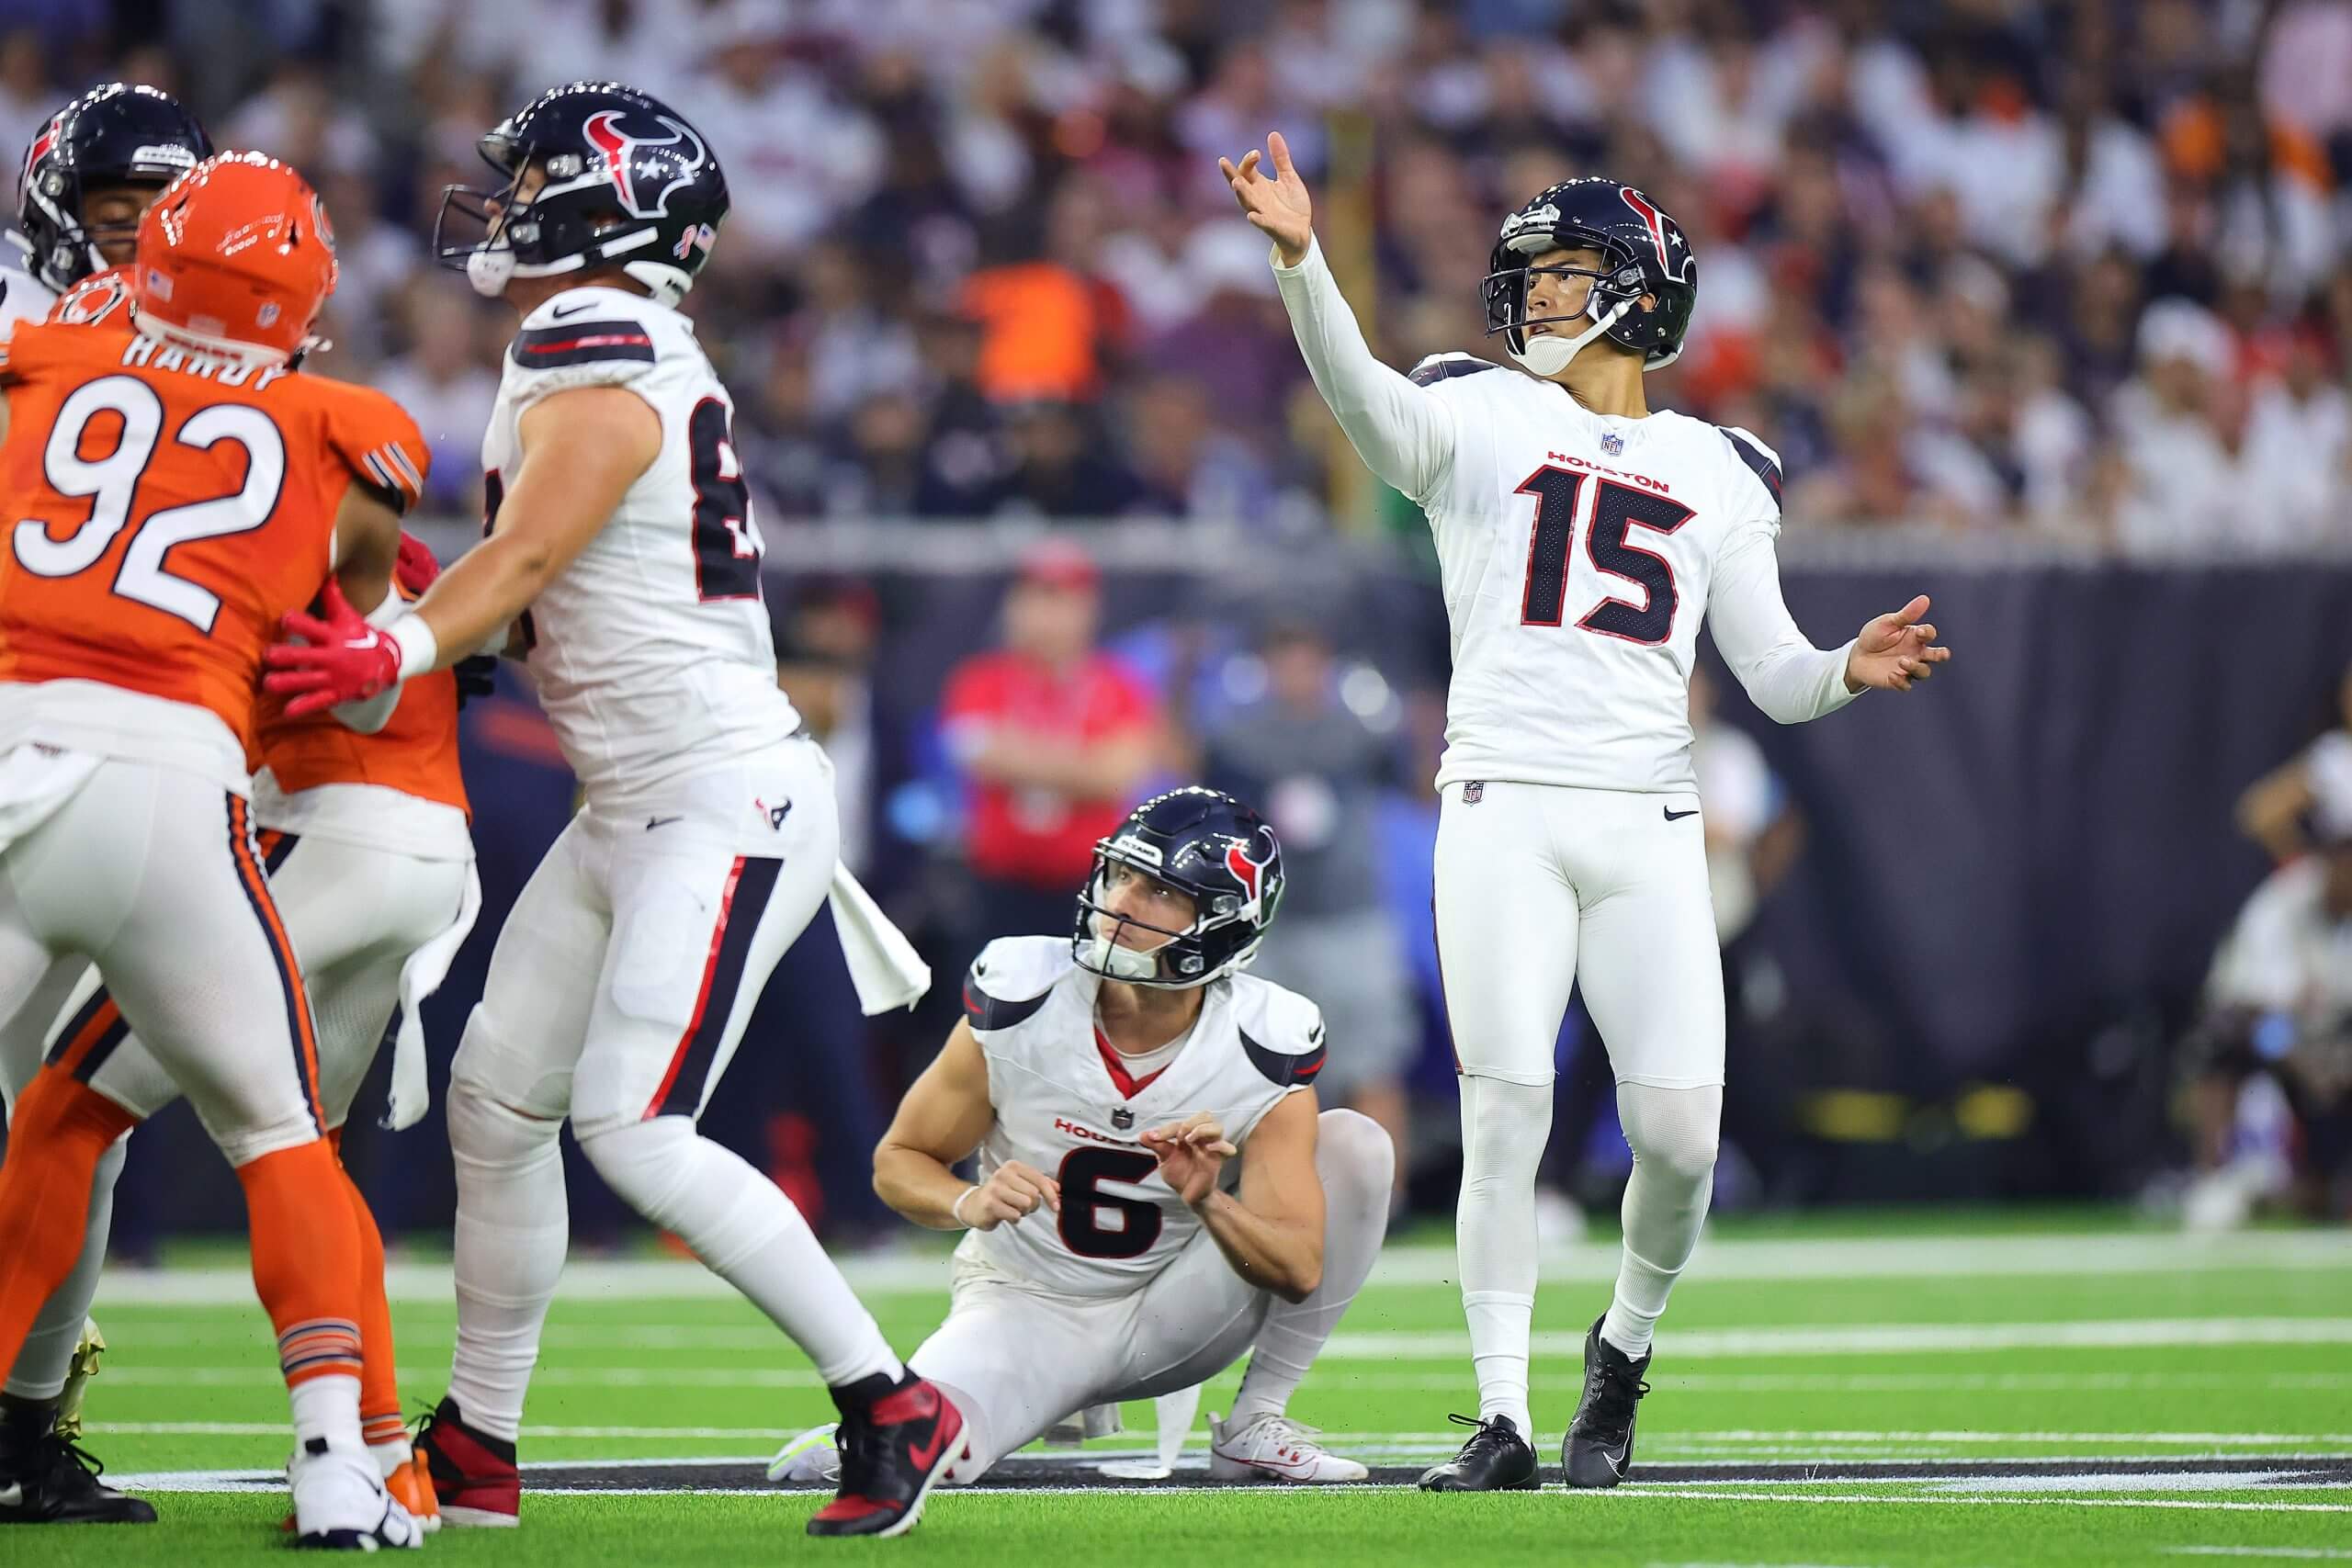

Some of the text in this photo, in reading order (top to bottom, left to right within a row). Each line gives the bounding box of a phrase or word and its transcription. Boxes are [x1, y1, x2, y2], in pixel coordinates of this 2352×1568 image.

[12, 374, 287, 637] 92
[1547, 451, 1669, 493] HOUSTON
[1512, 464, 1698, 647] 15
[1057, 1145, 1162, 1259] 6
